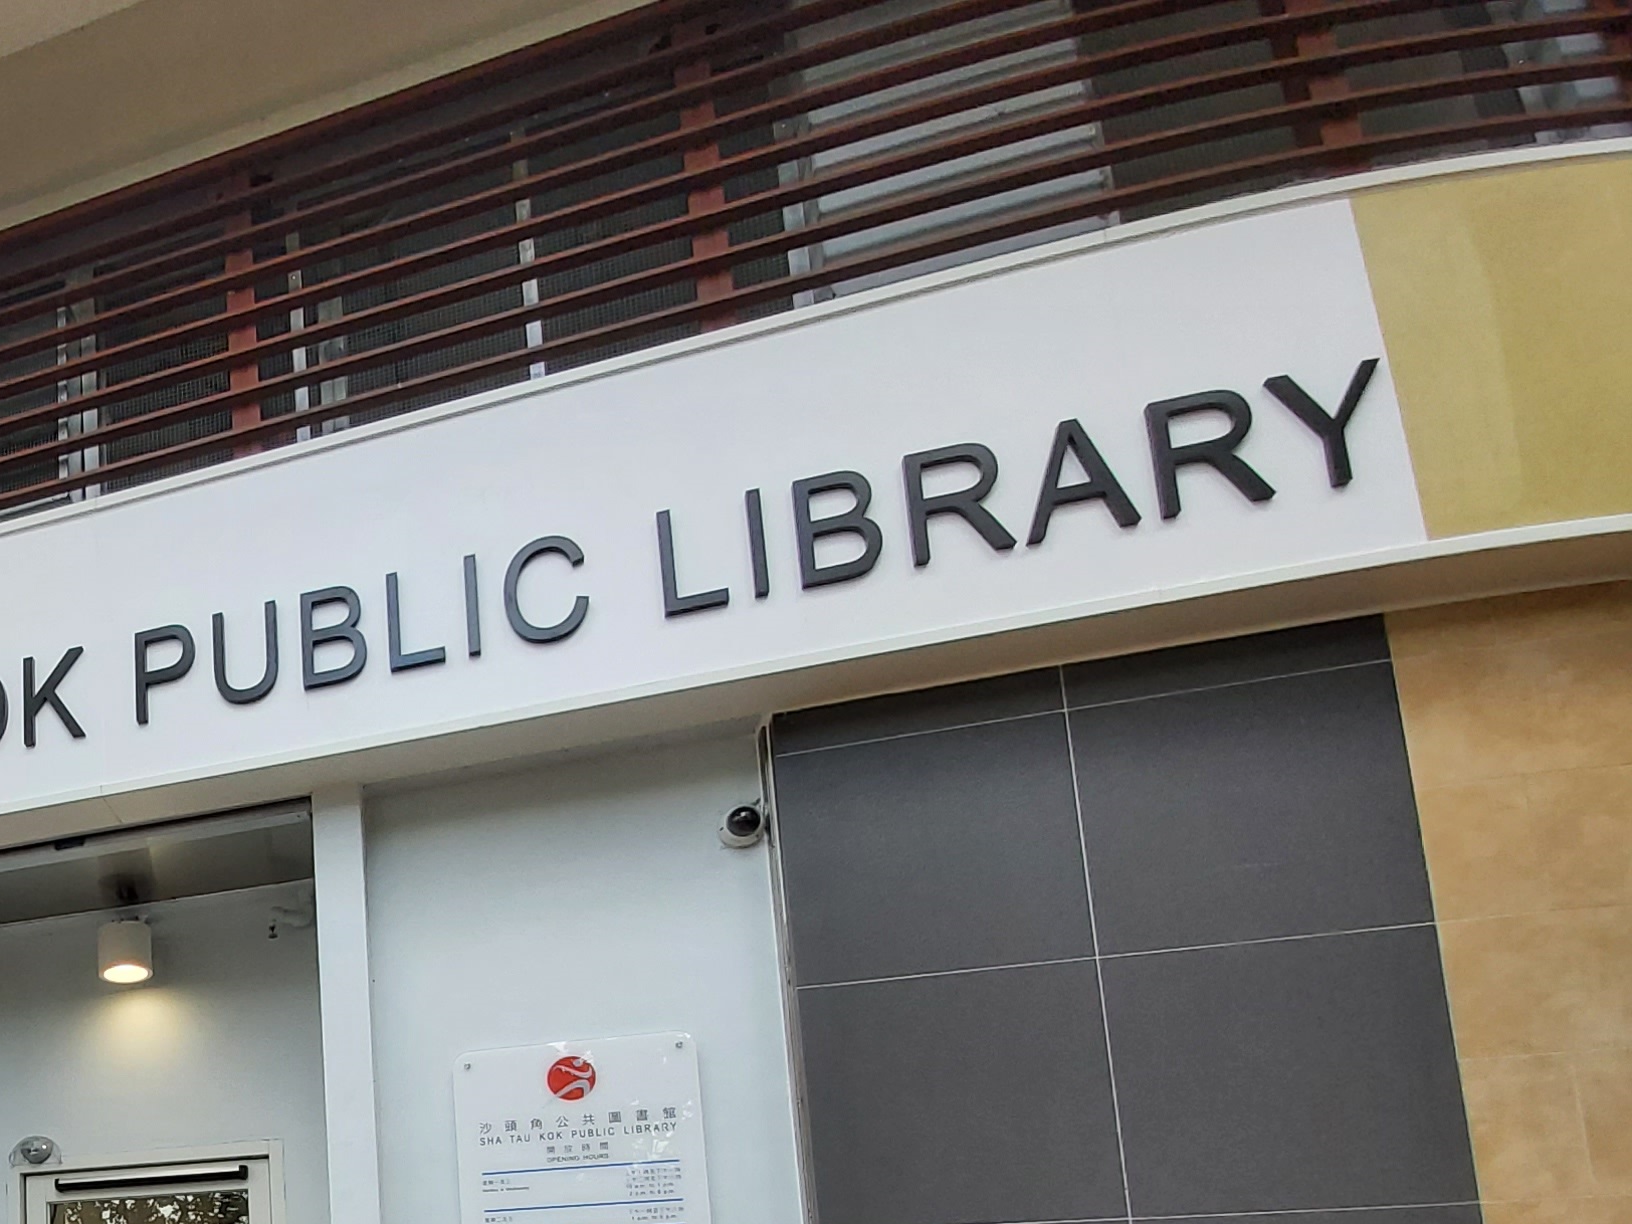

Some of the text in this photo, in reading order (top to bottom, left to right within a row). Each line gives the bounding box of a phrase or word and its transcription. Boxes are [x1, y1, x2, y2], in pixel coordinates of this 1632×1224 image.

[135, 536, 590, 725] PUBLIC
[657, 358, 1379, 619] LIBRARY
[479, 1107, 677, 1134] 沙頭角公共圖書館
[479, 1122, 677, 1146] SHA TAU KOK PUBLIC LIBRARY
